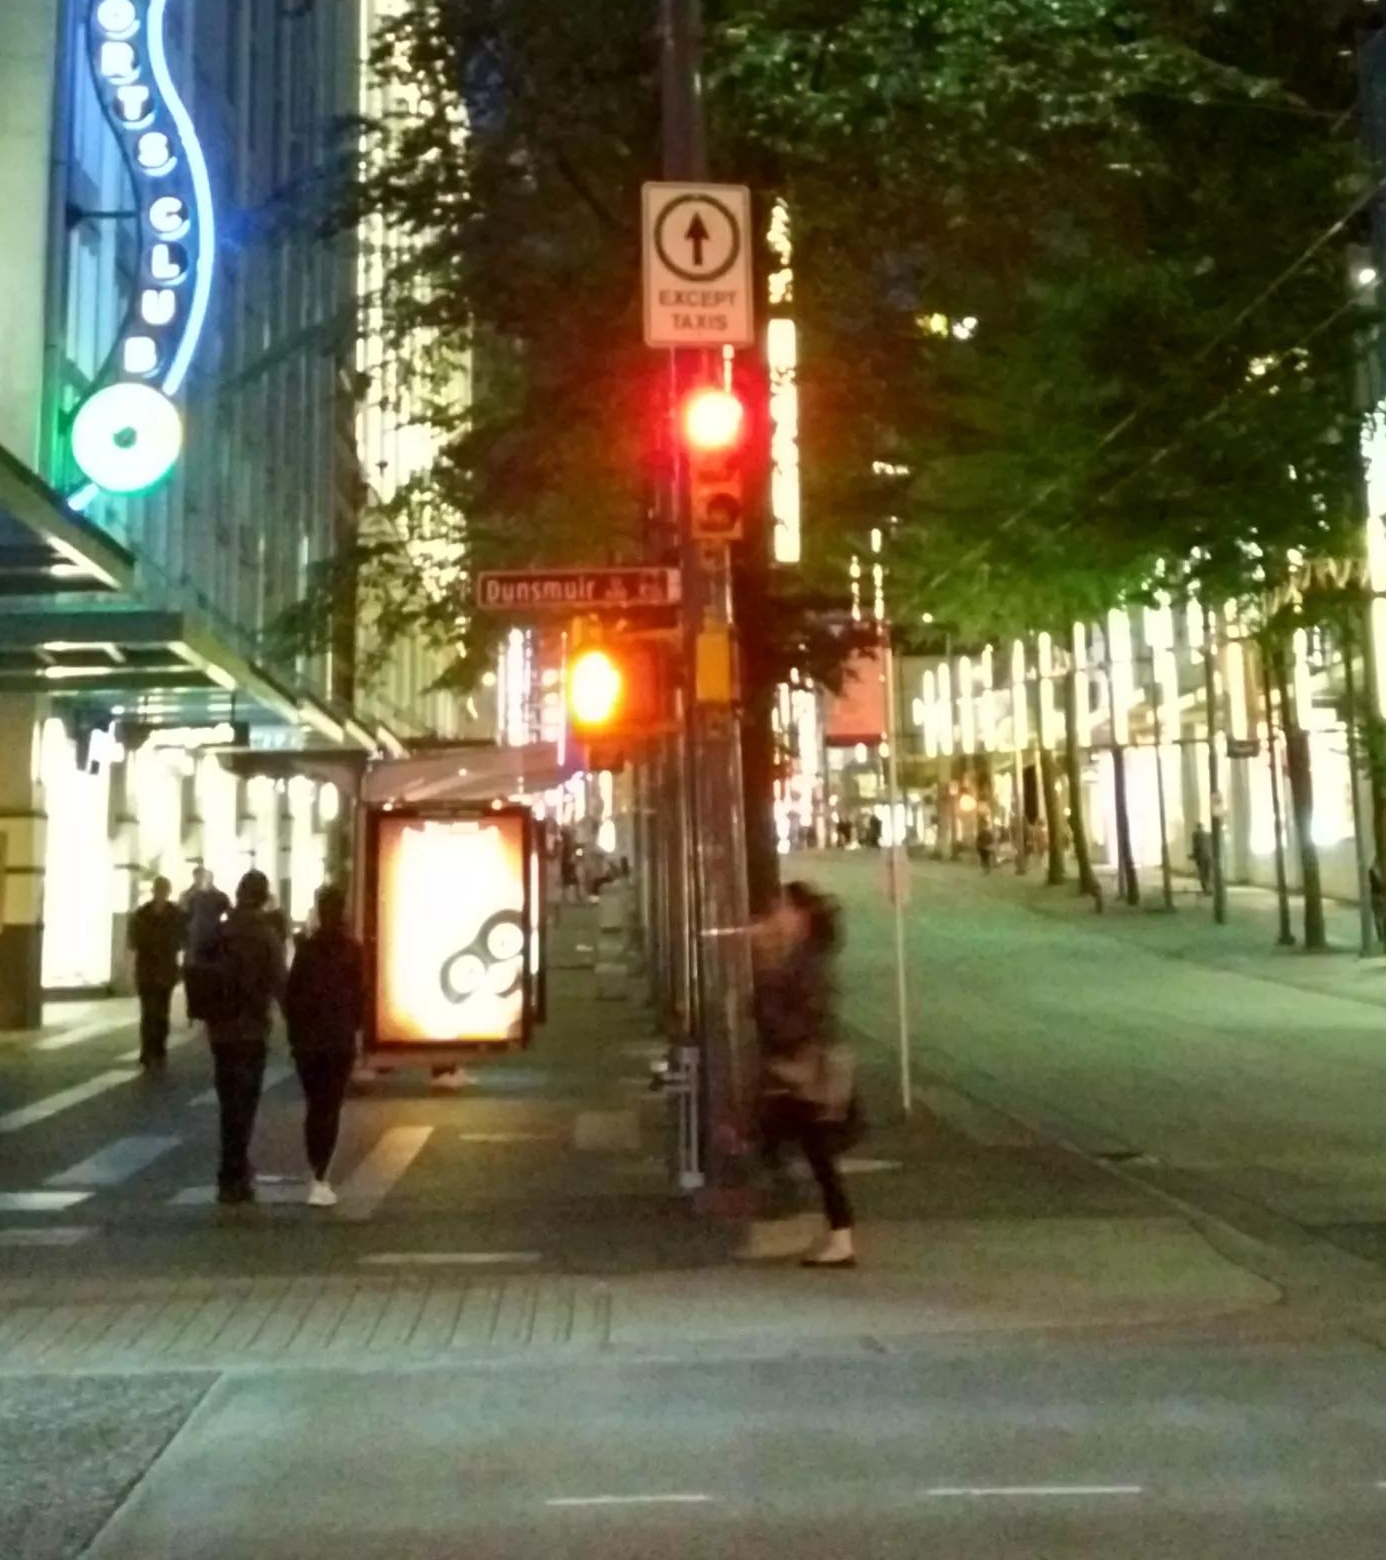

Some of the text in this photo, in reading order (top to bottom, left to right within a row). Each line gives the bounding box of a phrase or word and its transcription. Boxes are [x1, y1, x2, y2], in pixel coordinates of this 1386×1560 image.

[124, 196, 190, 376] CLUB
[658, 290, 737, 308] EXCEPT
[671, 313, 728, 331] TAXIS
[486, 574, 596, 603] Dunsmuir
